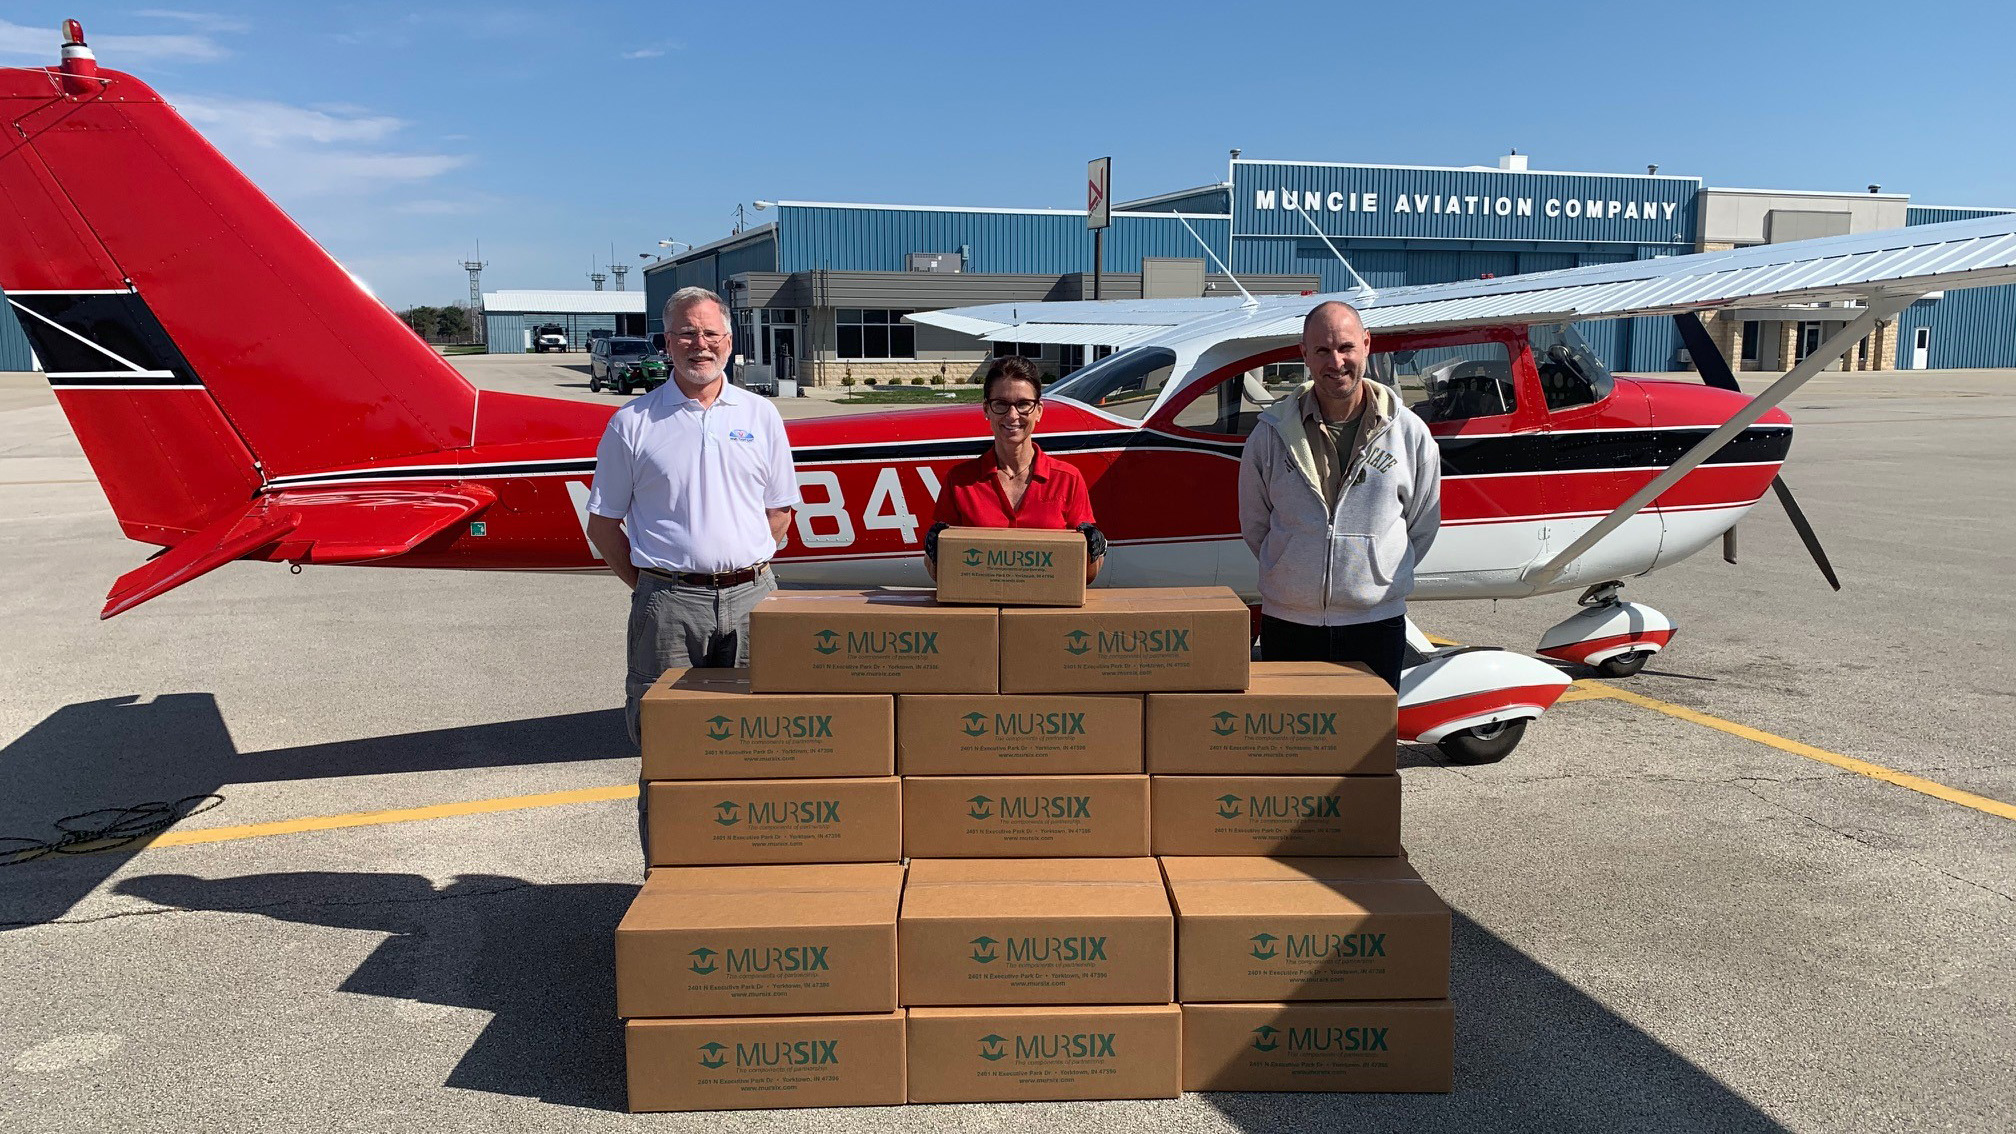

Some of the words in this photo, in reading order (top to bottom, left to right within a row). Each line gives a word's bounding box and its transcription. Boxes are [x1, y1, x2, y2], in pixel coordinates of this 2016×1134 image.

[1255, 189, 1378, 213] MUNCIE
[1394, 194, 1533, 218] AVIATION
[1544, 198, 1677, 221] COMPANY
[987, 549, 1053, 568] MURSIX
[848, 630, 939, 654] MURSIX
[1098, 629, 1190, 653] MURSIX
[740, 715, 833, 738] MURSIX
[995, 712, 1086, 735] MURSIX
[1245, 712, 1337, 735] MURSIX
[748, 800, 841, 824] MURSIX
[1000, 796, 1091, 818] MURSIX
[1250, 795, 1341, 818] MURSIX
[1007, 936, 1107, 961] MURSIX
[1286, 933, 1387, 958] MURSIX
[726, 946, 829, 972] MURSIX
[1016, 1033, 1116, 1059] MURSIX
[1288, 1026, 1389, 1052] MURSIX
[736, 1040, 839, 1066] MURSIX
